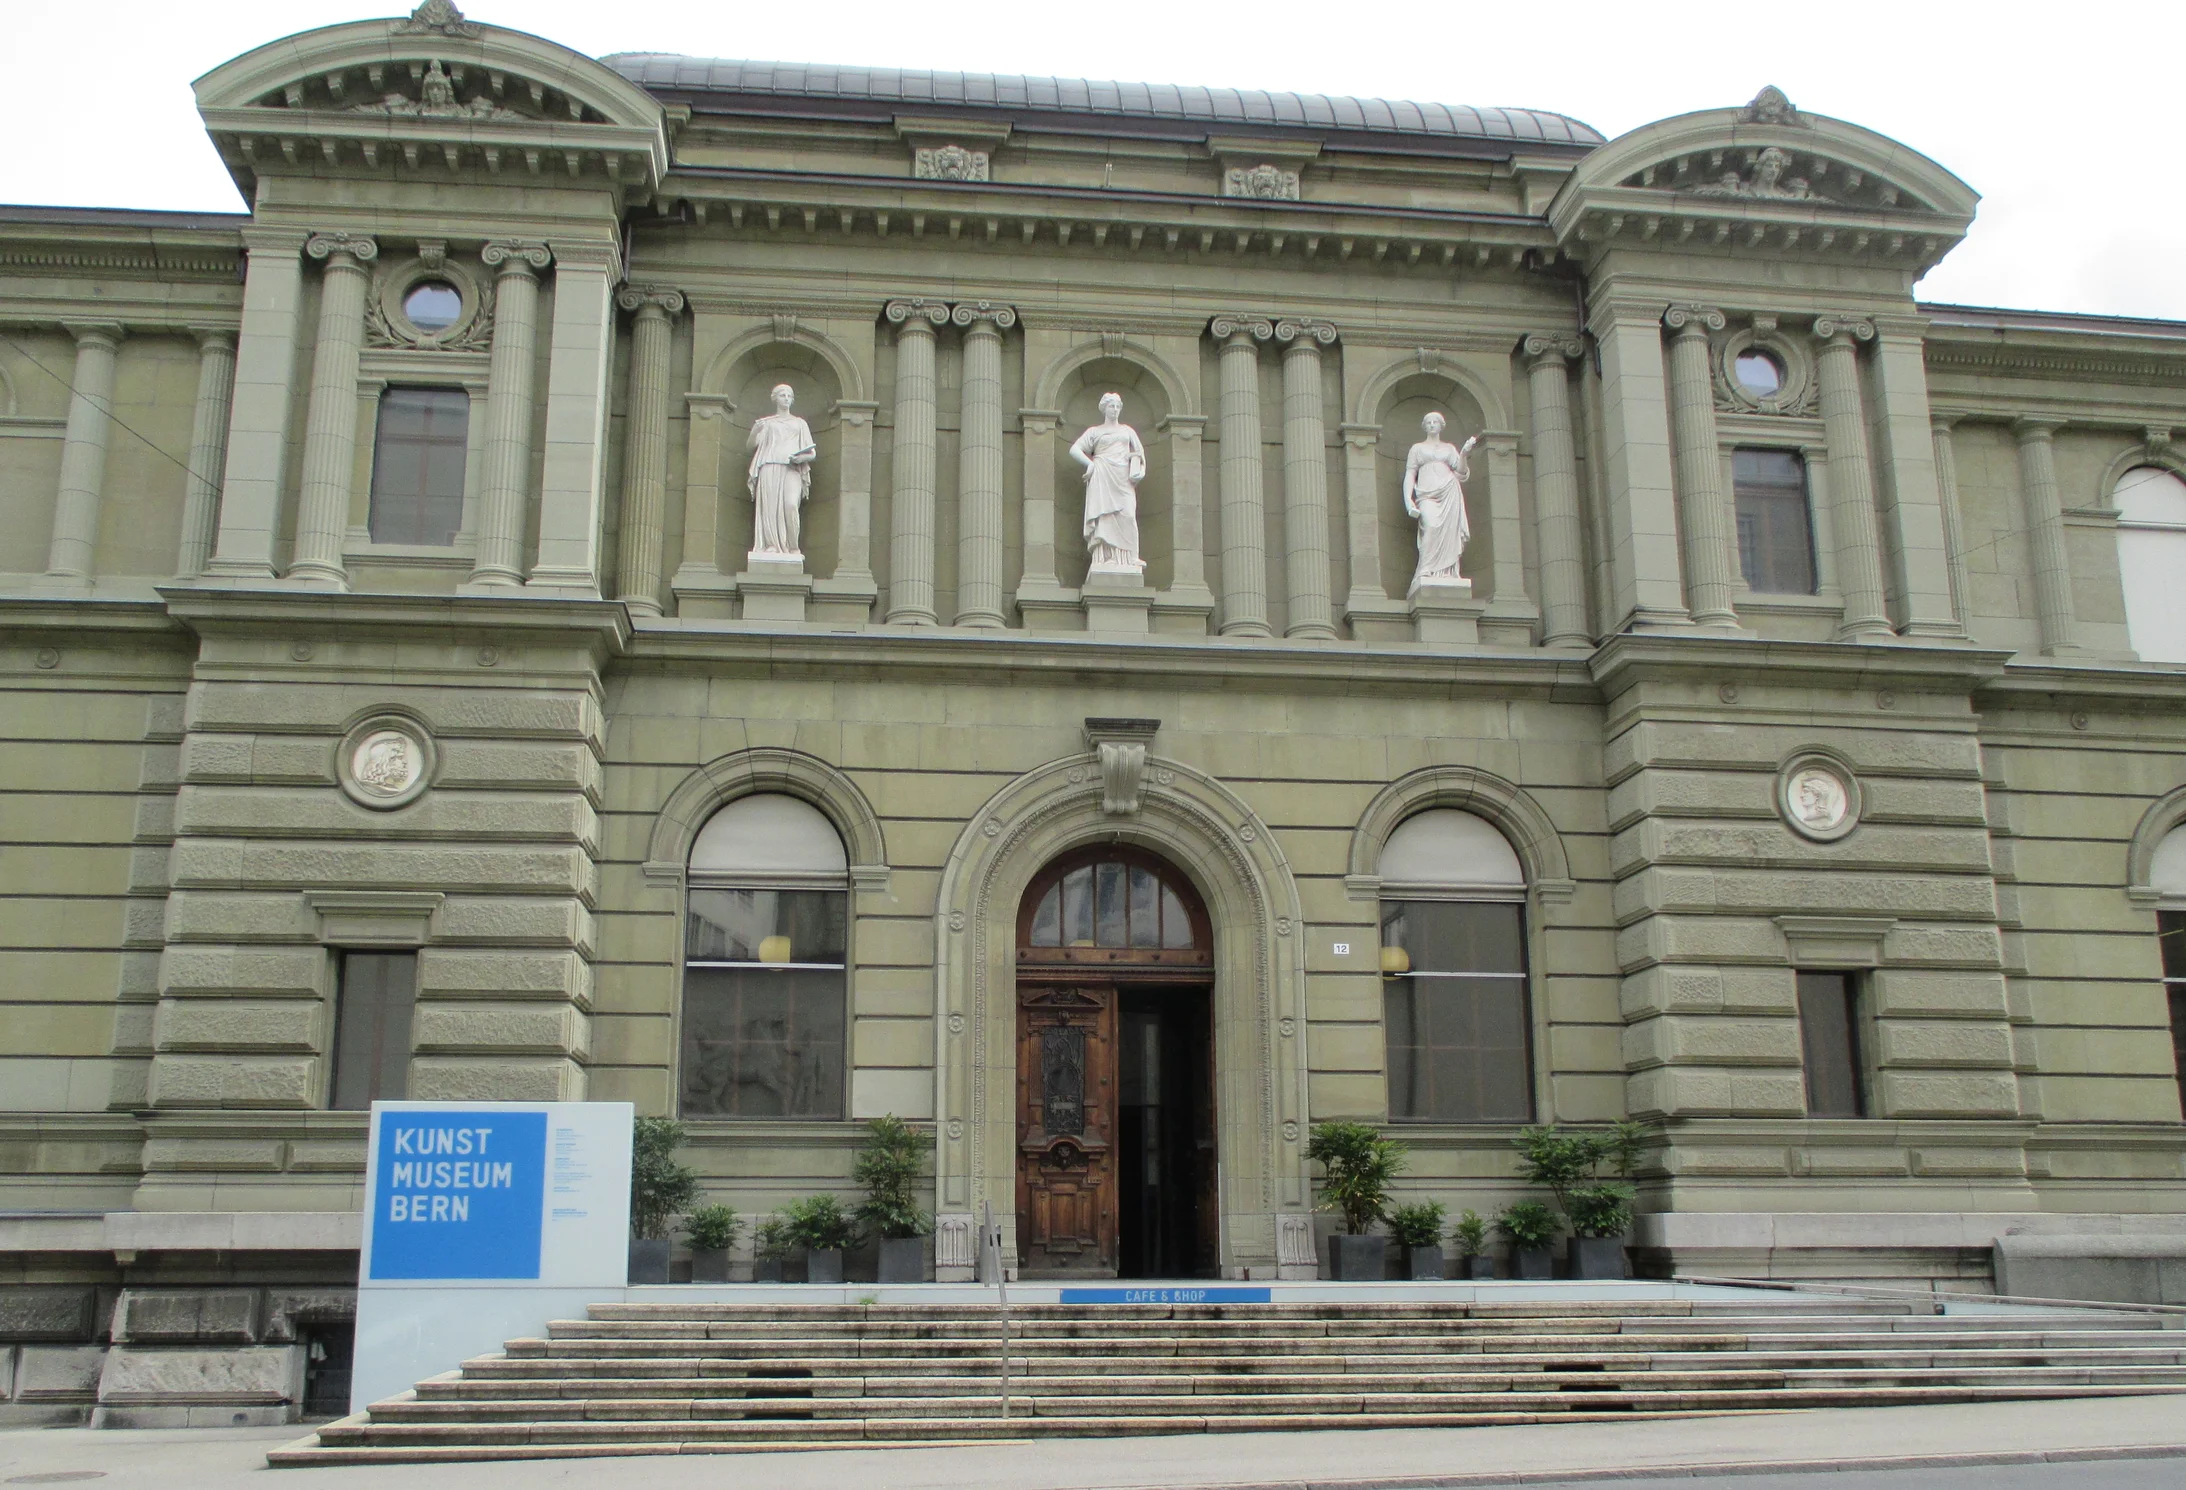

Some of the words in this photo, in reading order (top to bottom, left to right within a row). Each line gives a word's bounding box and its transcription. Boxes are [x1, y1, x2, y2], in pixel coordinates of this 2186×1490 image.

[1336, 945, 1347, 953] 12
[394, 1128, 493, 1155] KUNST
[392, 1162, 513, 1188] MUSEUM
[390, 1195, 469, 1222] BERN
[1125, 1290, 1156, 1302] CAFE
[1161, 1290, 1168, 1301] &
[1174, 1290, 1205, 1301] SHOP
